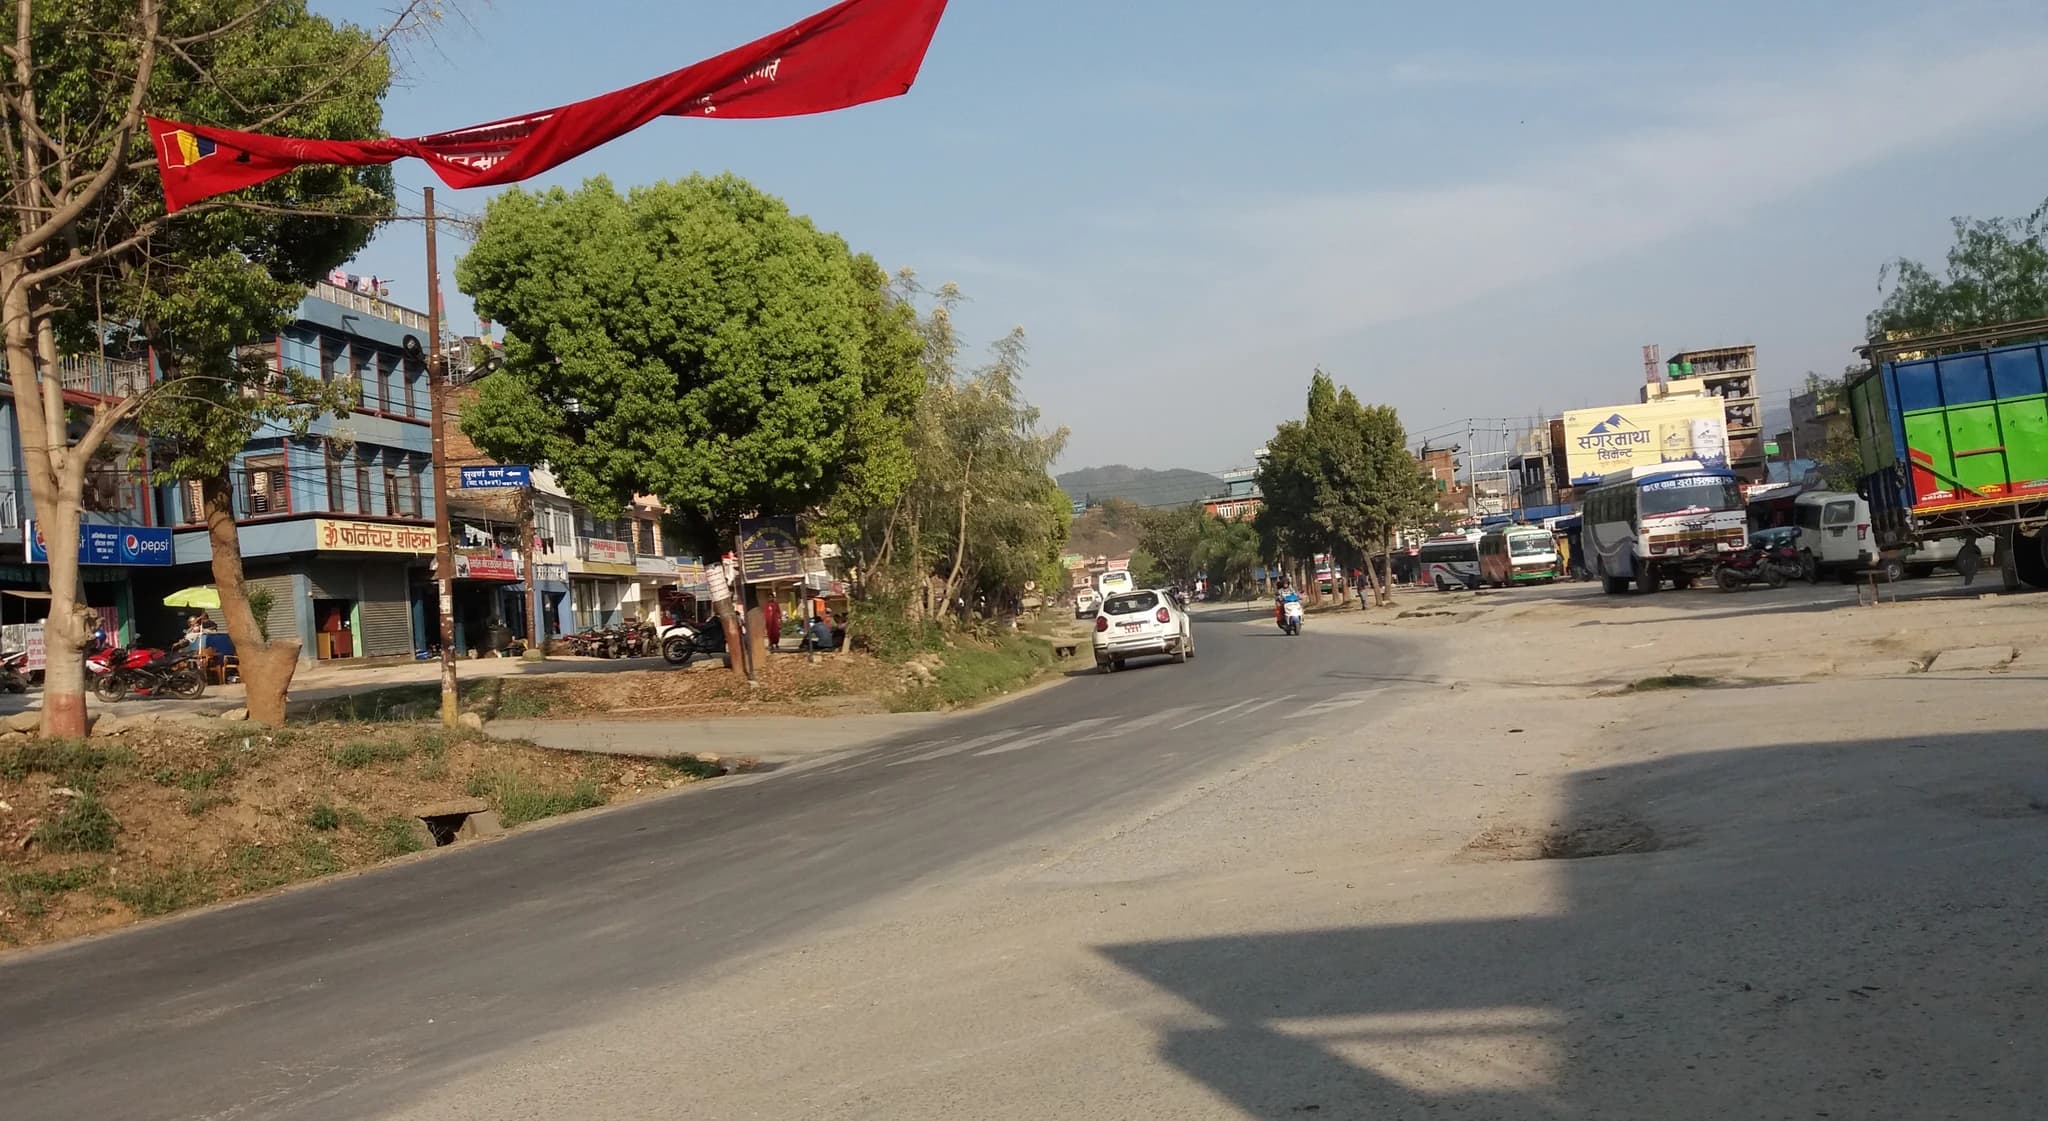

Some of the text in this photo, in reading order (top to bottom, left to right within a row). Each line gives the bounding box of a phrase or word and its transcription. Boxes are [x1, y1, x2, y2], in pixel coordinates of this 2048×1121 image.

[1577, 430, 1650, 449] सगरमाथा
[487, 468, 505, 478] मार्ग
[140, 538, 169, 553] pepsi
